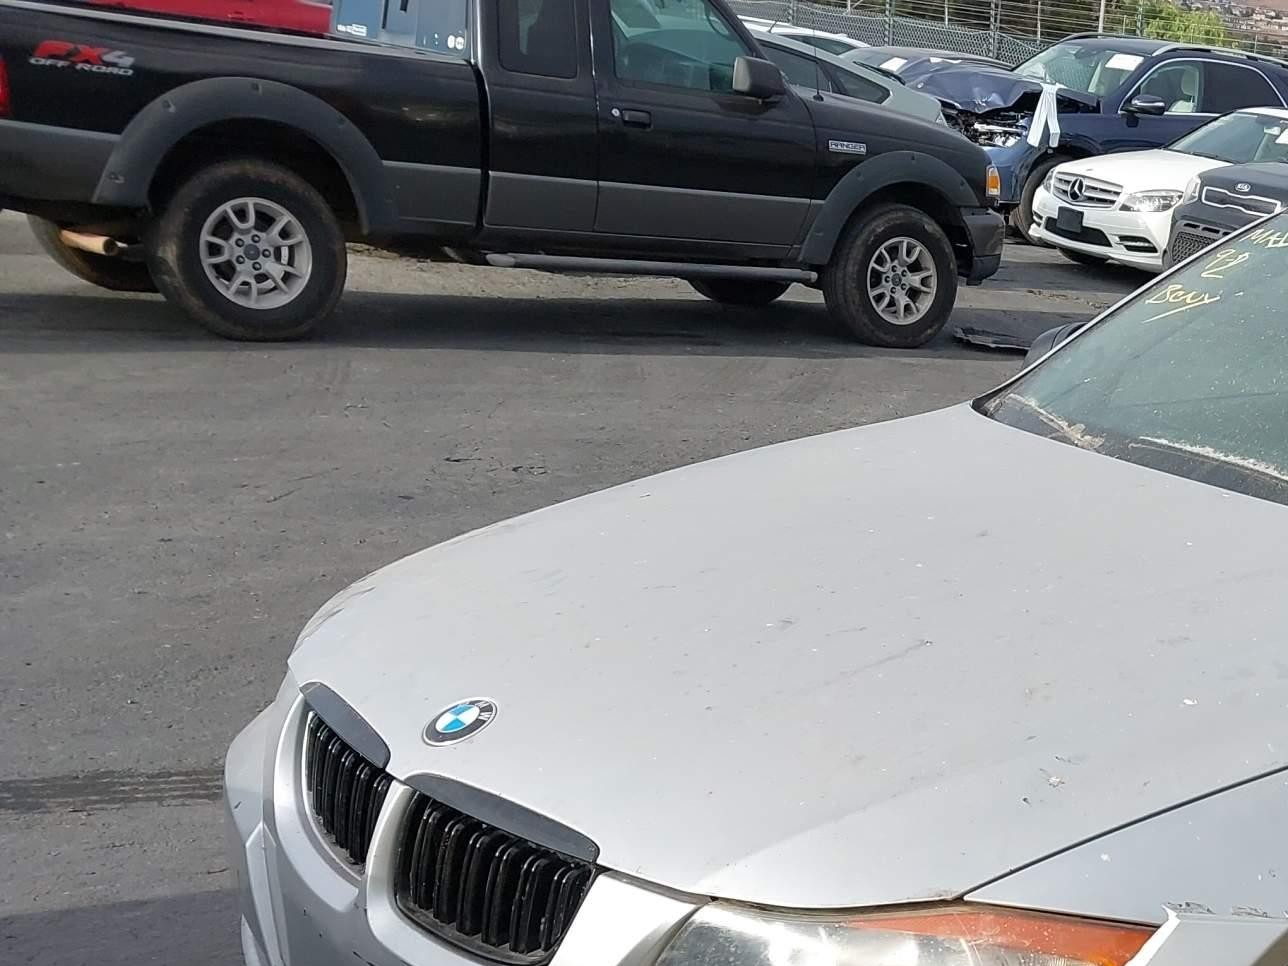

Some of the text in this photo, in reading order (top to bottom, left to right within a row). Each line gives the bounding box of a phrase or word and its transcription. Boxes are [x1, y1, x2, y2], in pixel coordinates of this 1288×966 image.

[33, 40, 136, 68] FX4
[29, 57, 134, 76] OFF ROAD
